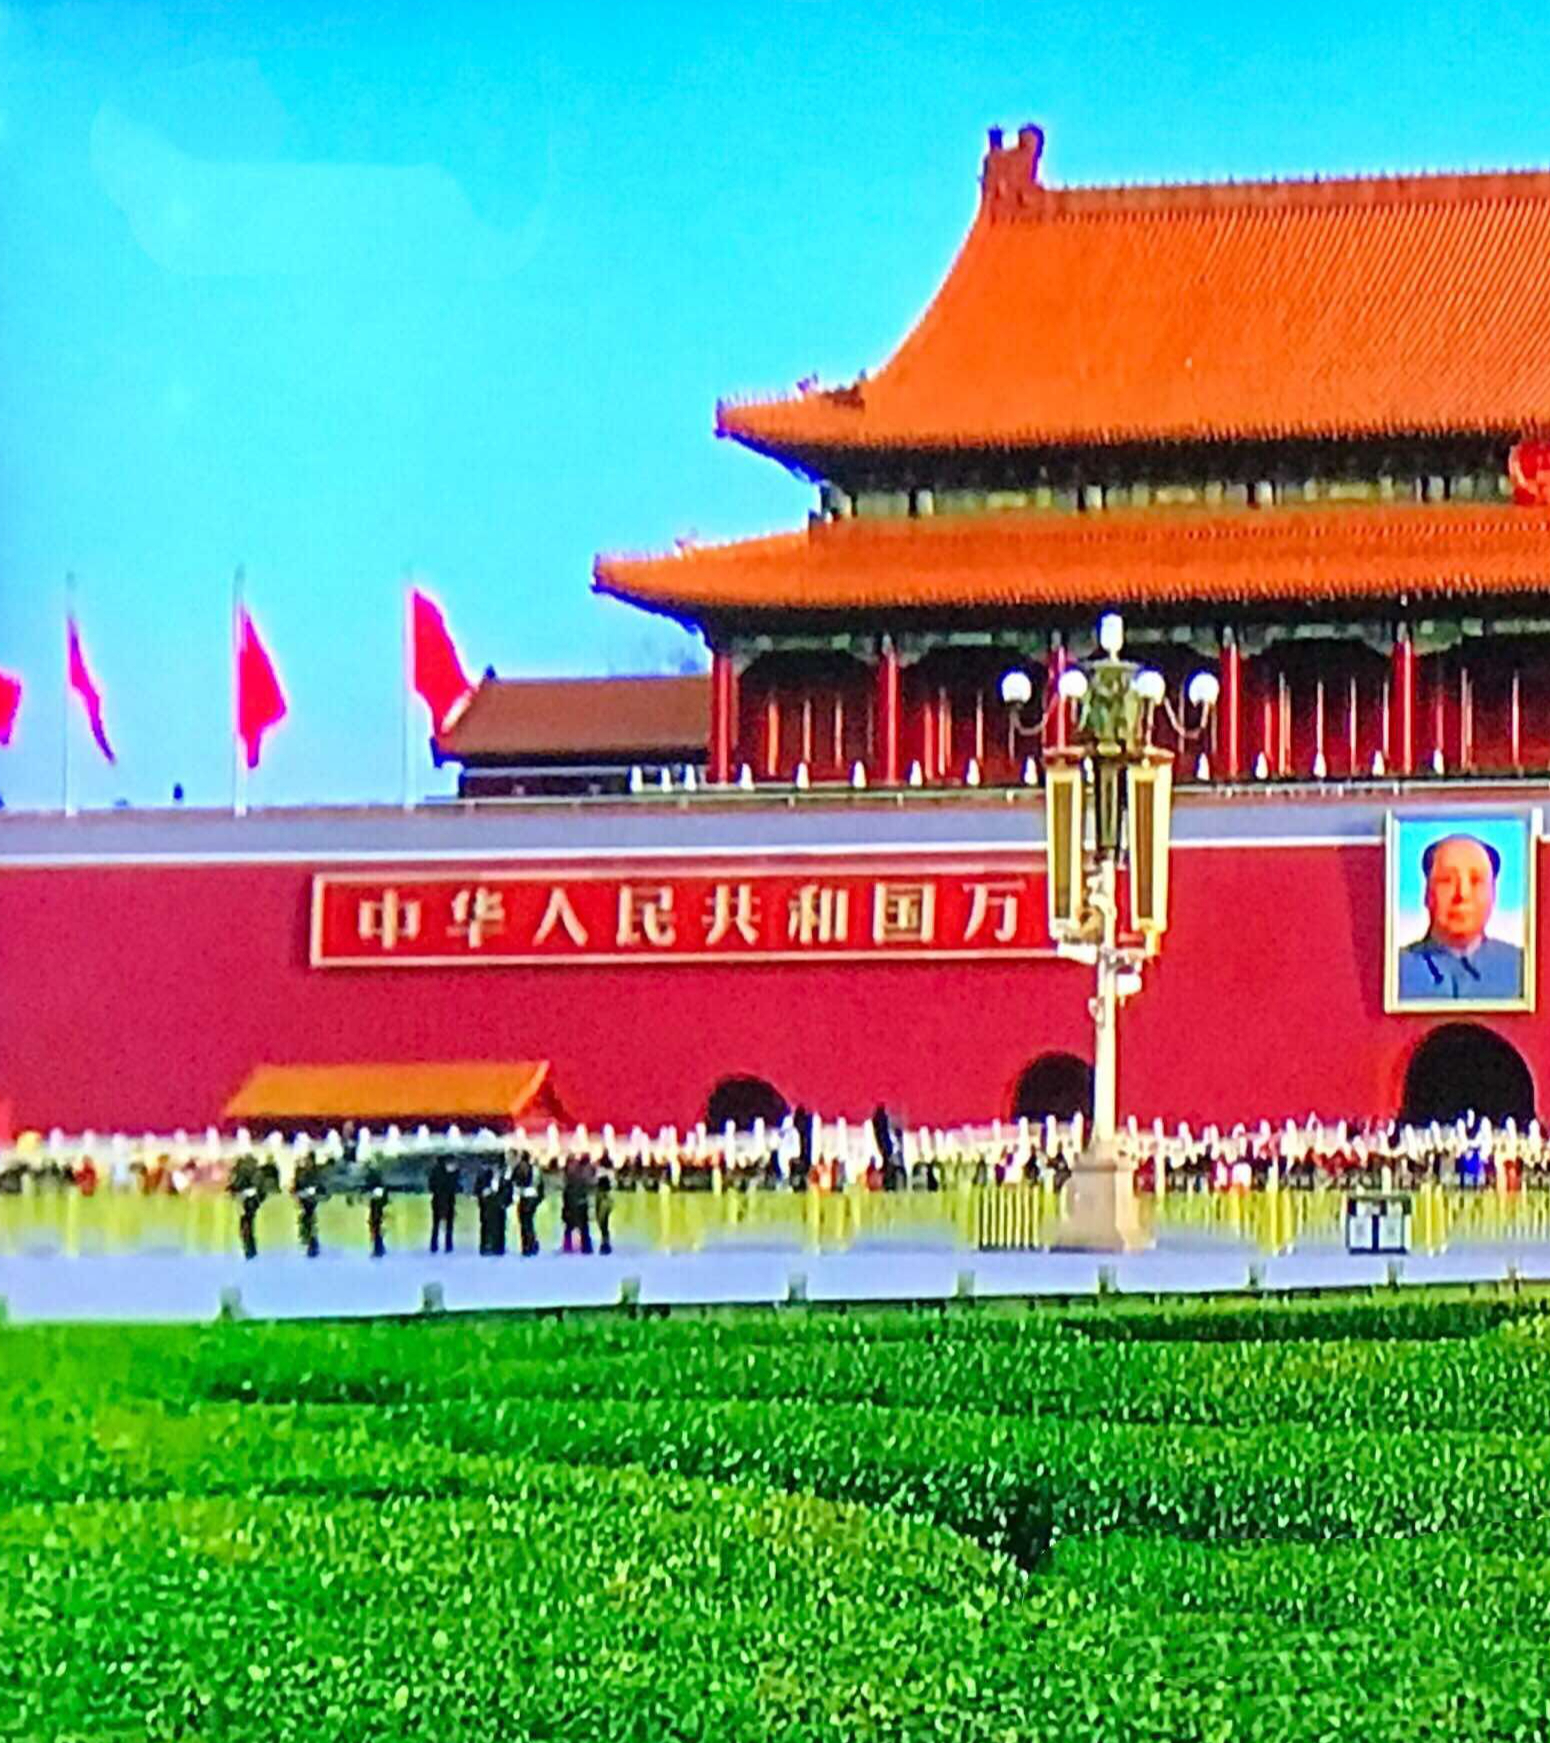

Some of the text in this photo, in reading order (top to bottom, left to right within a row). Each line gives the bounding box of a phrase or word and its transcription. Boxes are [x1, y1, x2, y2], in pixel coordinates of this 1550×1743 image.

[357, 881, 1104, 950] 中华人民共和国万
